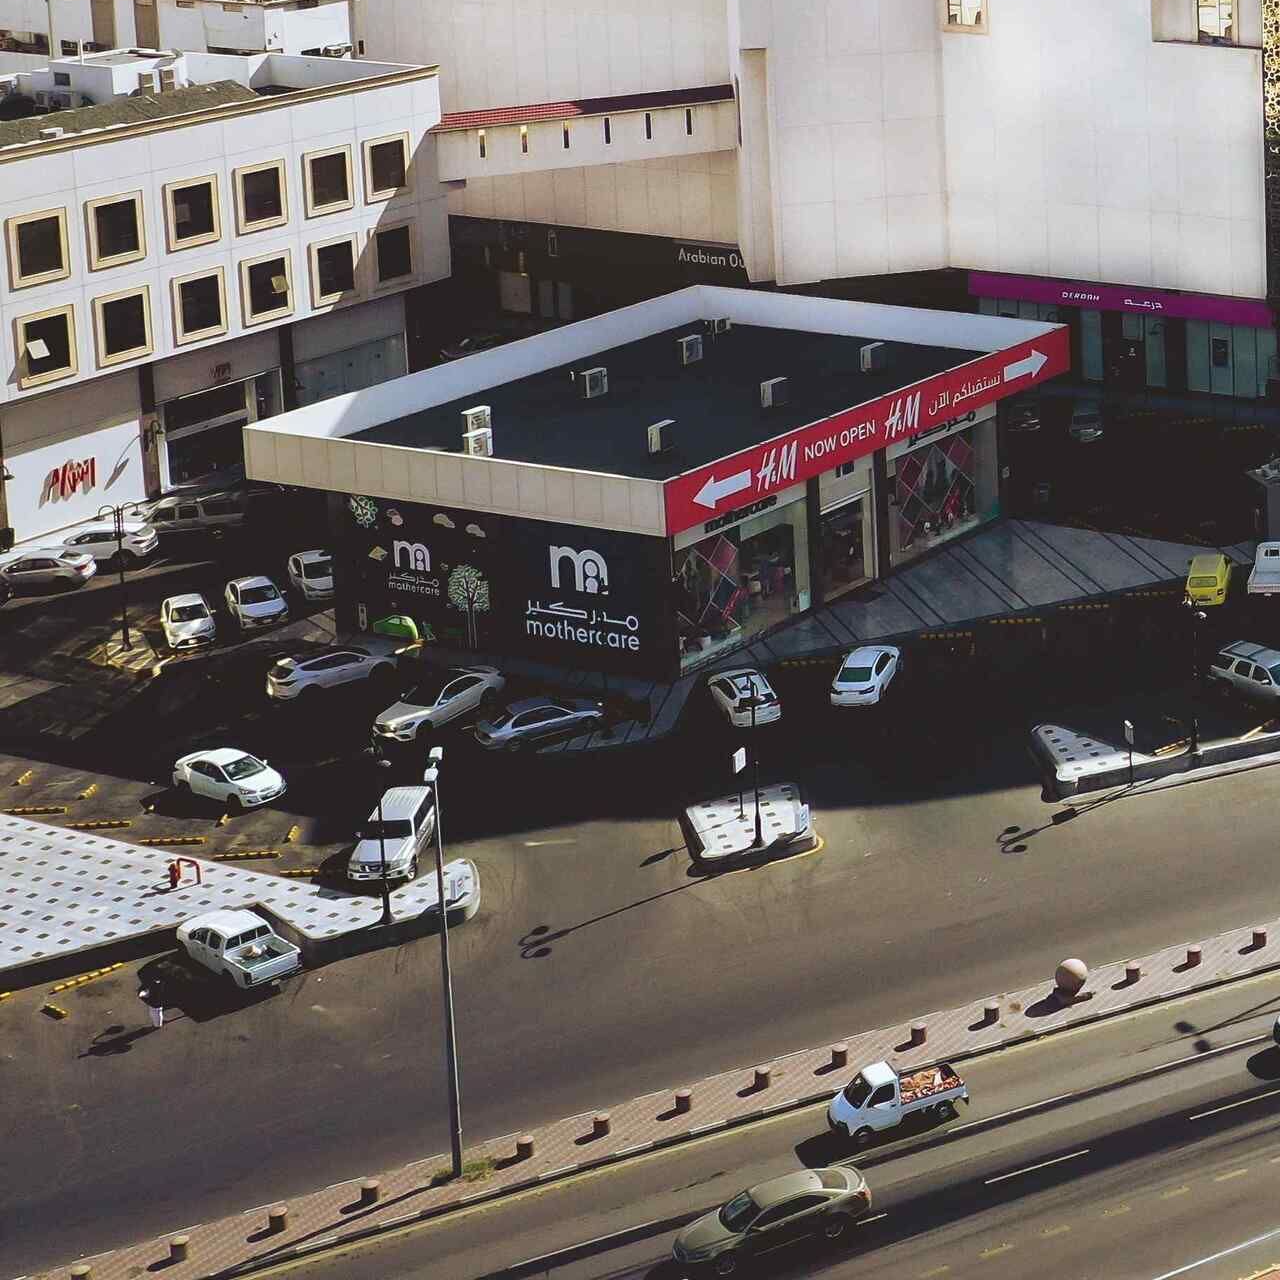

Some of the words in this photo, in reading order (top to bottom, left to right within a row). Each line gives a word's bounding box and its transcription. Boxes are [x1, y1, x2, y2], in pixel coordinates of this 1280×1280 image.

[678, 247, 726, 266] Arabian
[928, 389, 950, 416] الآن
[952, 371, 1001, 408] نستقبلكم
[756, 440, 798, 492] H&M
[804, 434, 837, 462] NOW
[840, 419, 876, 447] OPEN
[884, 391, 921, 440] H&M
[388, 581, 440, 596] mothercare
[526, 618, 640, 651] mothercare
